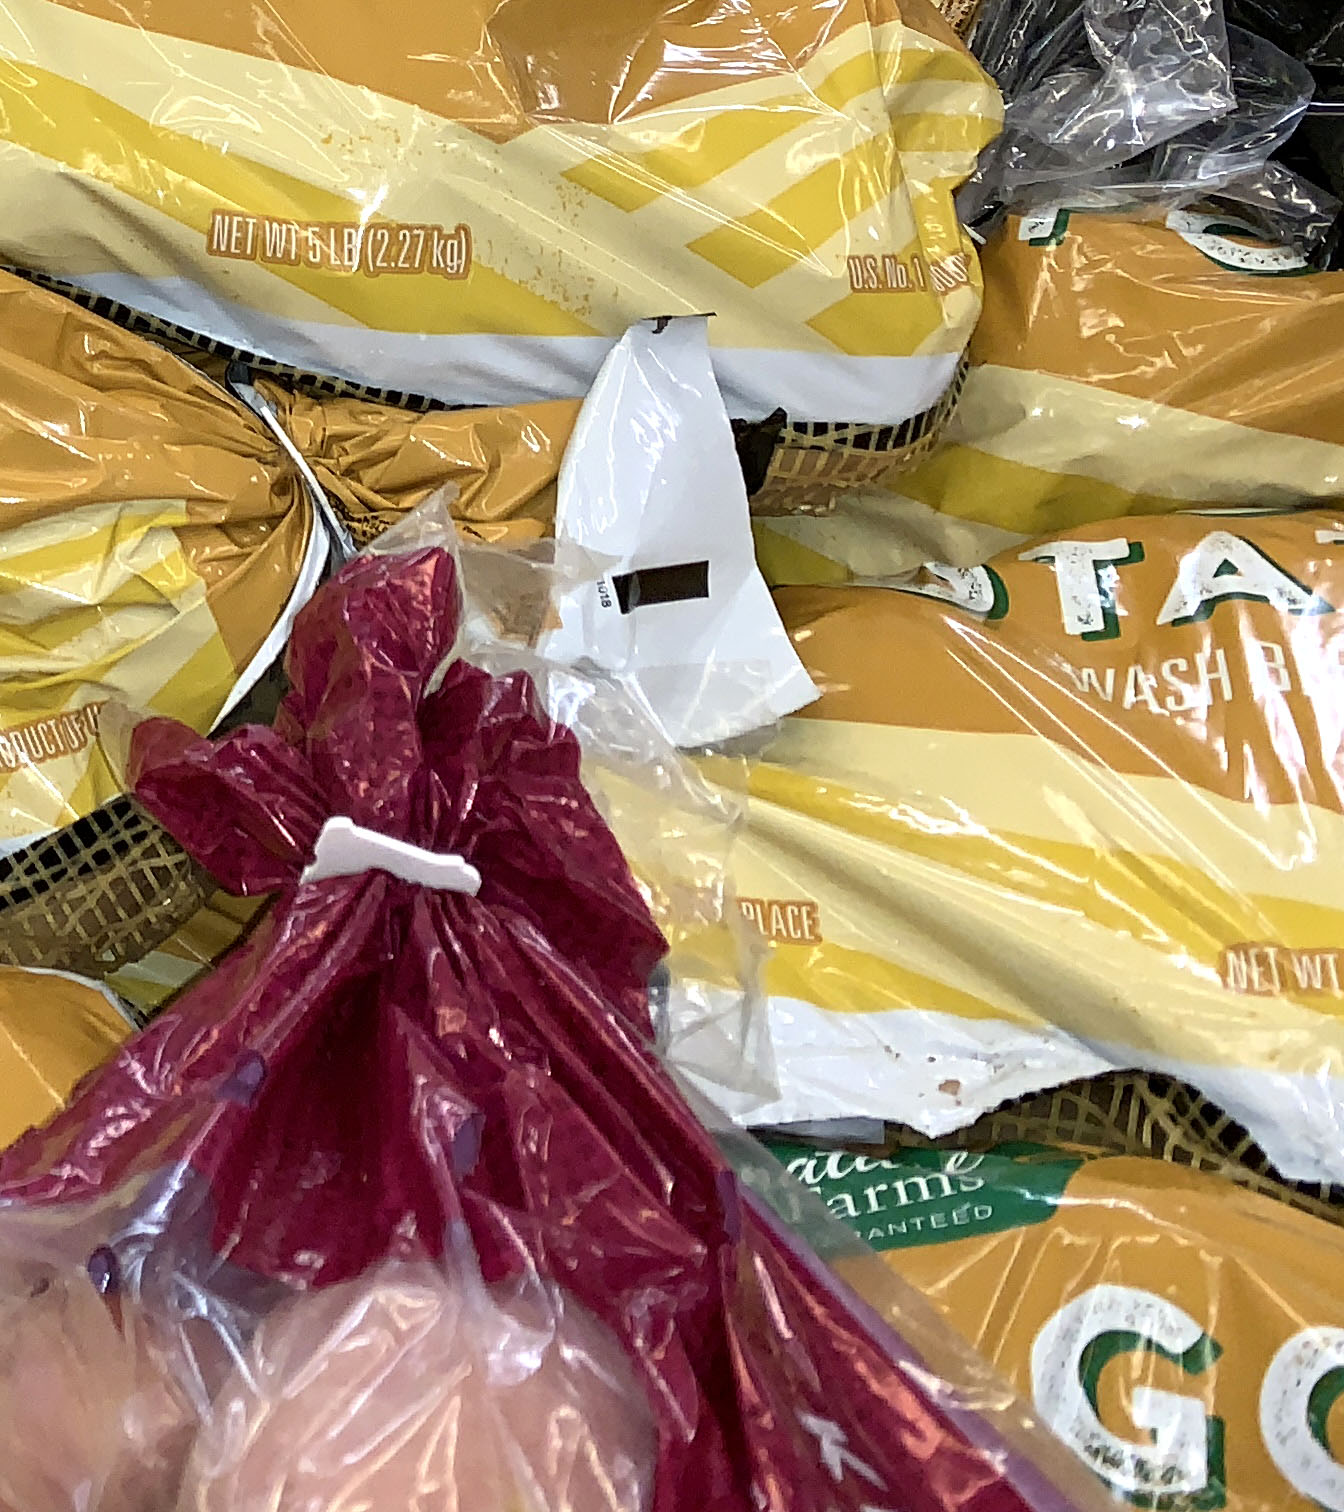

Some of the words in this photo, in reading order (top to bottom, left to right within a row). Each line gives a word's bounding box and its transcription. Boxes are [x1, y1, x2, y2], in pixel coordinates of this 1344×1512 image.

[212, 214, 257, 255] NET
[264, 219, 299, 261] WT
[307, 226, 321, 264] 5
[329, 226, 358, 267] LB
[367, 227, 425, 273] (2.27
[432, 229, 468, 274] kg)
[848, 257, 882, 289] U.S.
[884, 257, 913, 289] No.
[1225, 946, 1281, 994] NET
[1290, 952, 1341, 999] WT
[810, 1172, 985, 1220] arms
[857, 1201, 994, 1241] ANTEED
